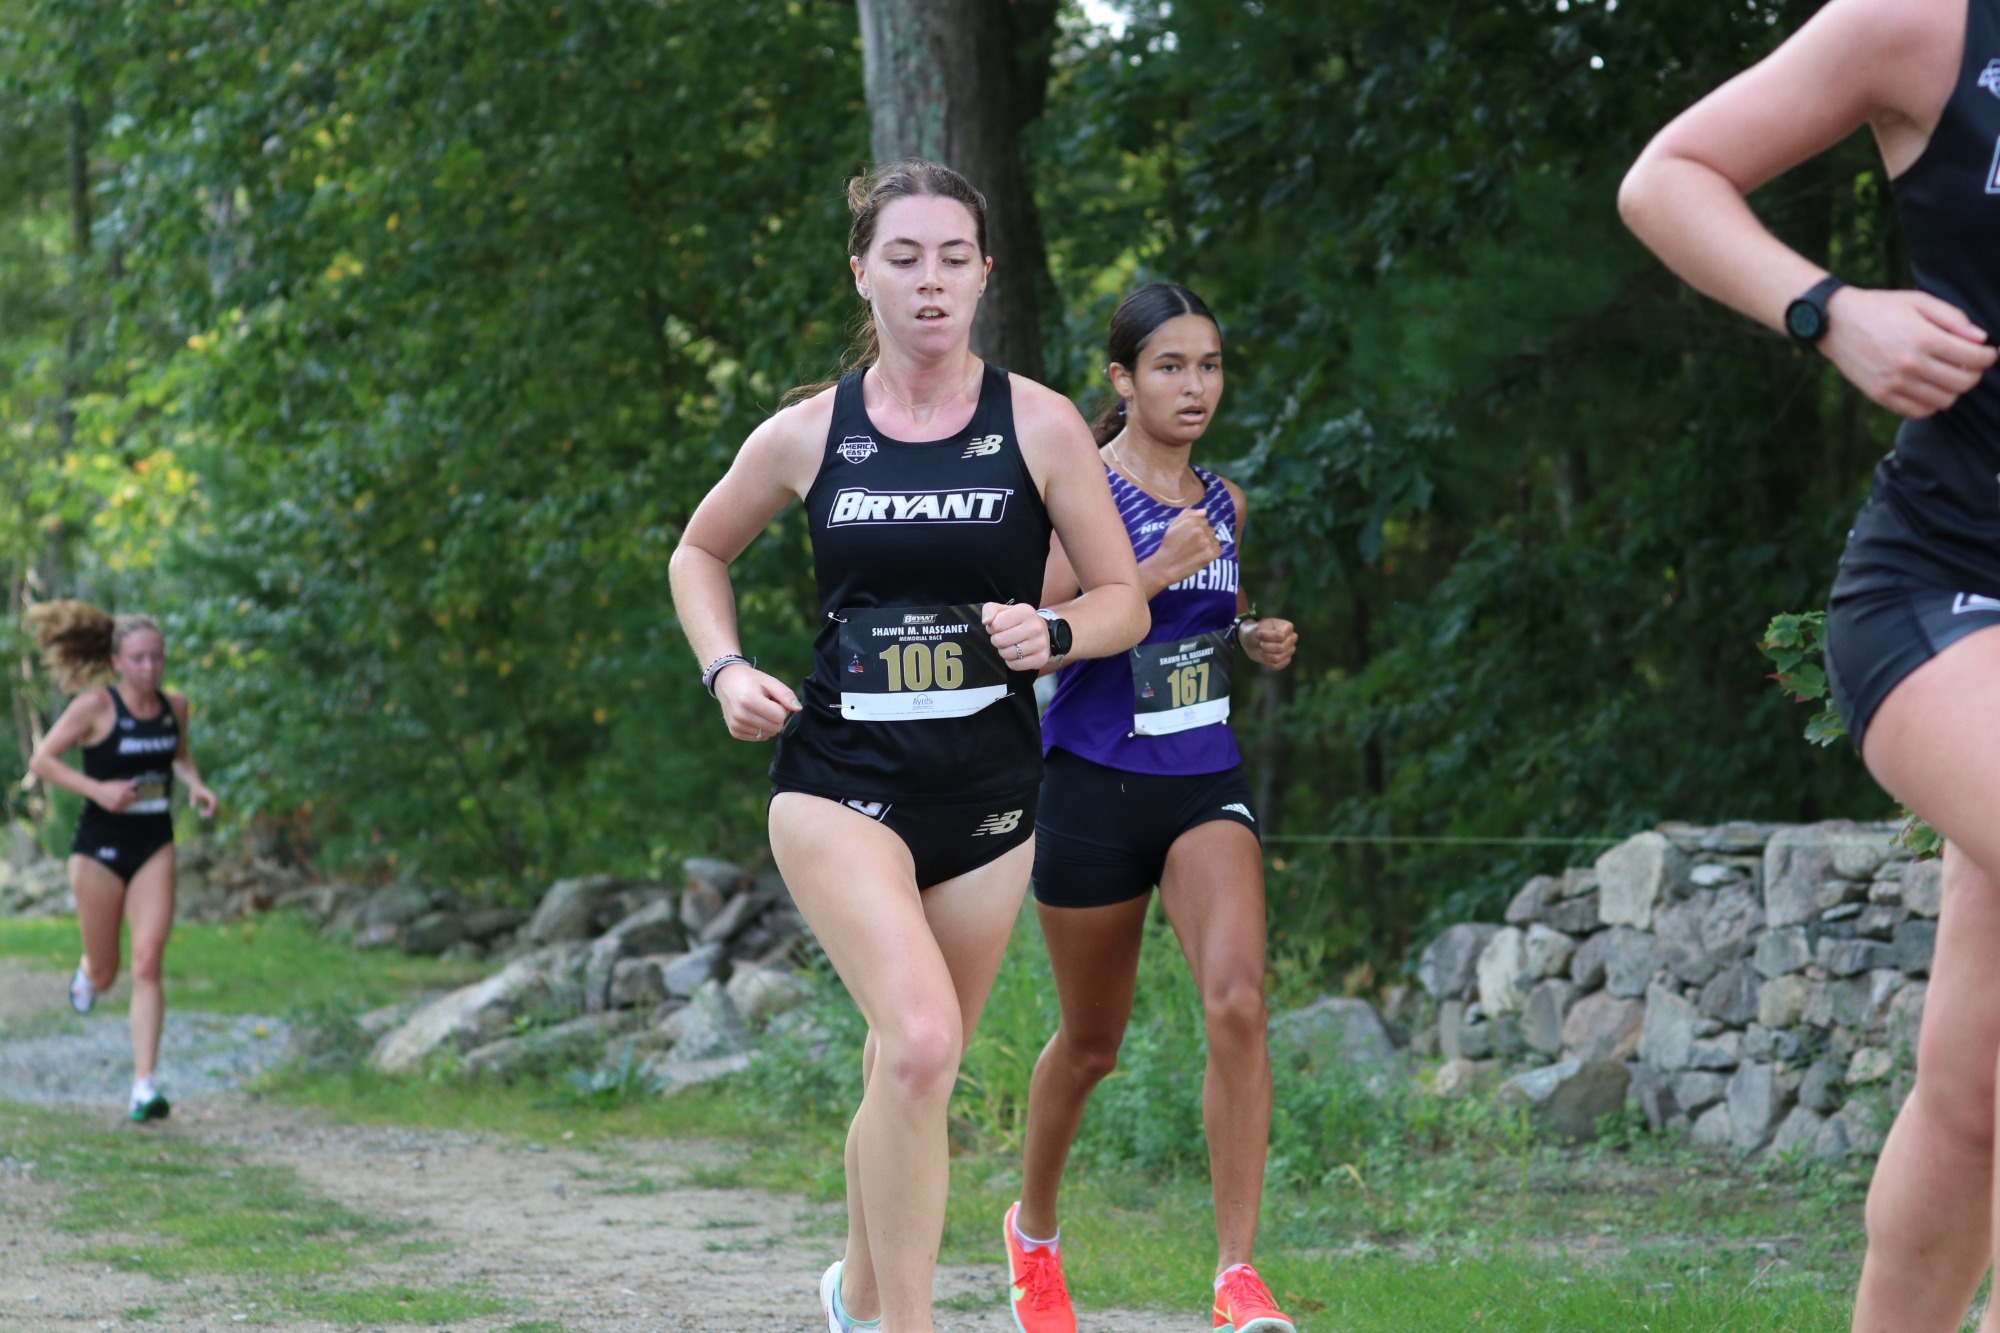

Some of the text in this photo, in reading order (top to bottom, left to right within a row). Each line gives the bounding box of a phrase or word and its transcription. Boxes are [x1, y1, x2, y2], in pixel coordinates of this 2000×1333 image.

[840, 443, 876, 451] AMERICA
[831, 492, 1004, 523] BRYANT
[872, 624, 968, 636] SHAWN M. NASSANEY
[904, 615, 935, 624] BRYANT
[879, 642, 963, 691] 106
[1167, 663, 1209, 708] 167
